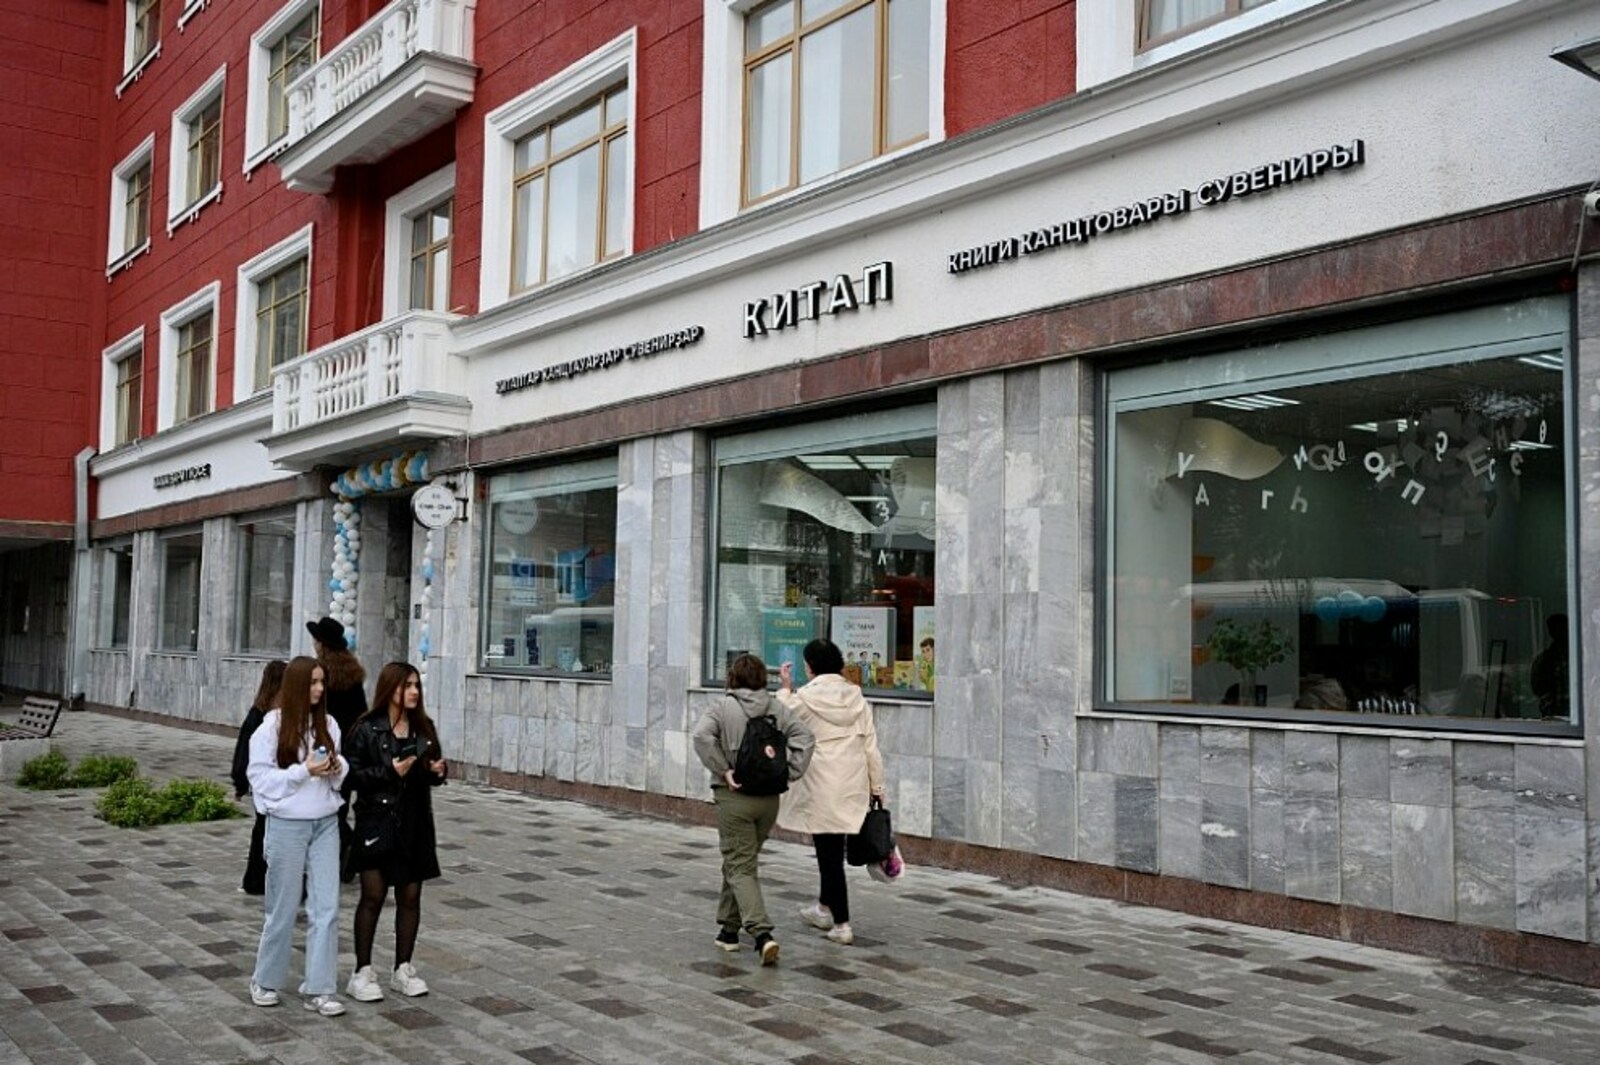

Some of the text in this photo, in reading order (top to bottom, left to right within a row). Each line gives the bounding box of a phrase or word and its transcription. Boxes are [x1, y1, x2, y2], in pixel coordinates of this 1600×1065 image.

[947, 138, 1366, 274] КНИГИ КАНЦТОВАРЫ СУВЕНИРЫ
[743, 261, 893, 338] КИТАП
